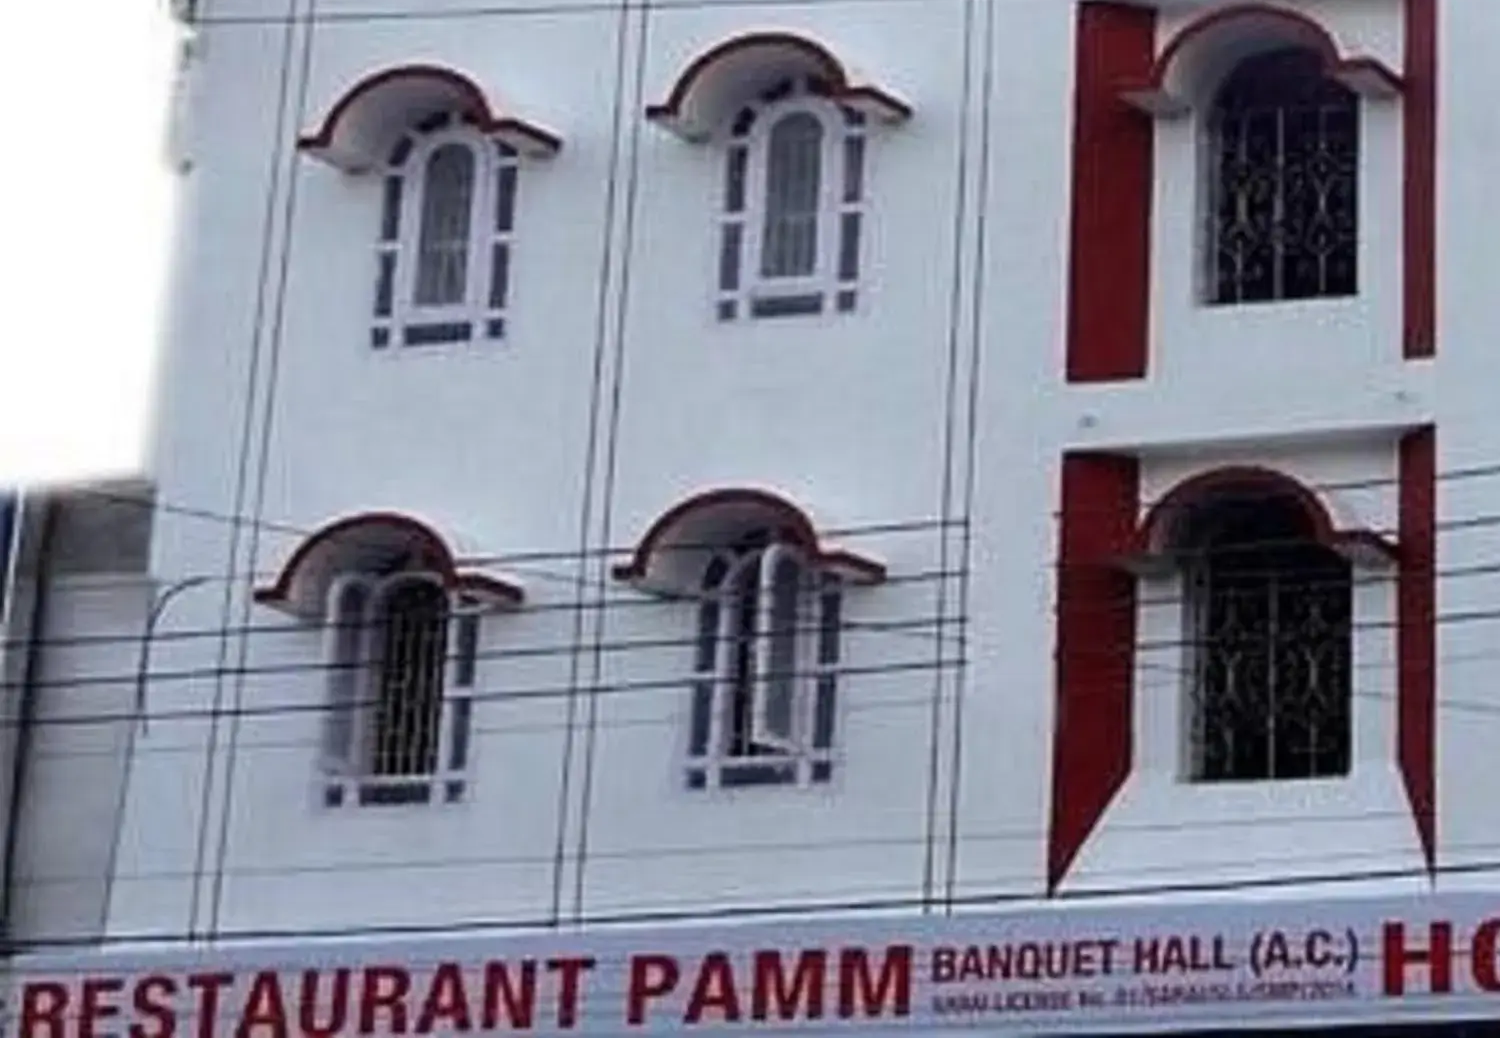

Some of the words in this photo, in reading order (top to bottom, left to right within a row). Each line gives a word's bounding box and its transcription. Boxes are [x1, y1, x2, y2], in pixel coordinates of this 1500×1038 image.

[20, 957, 596, 1038] RESTAURANT
[626, 945, 915, 1025] PAMM
[930, 938, 1120, 984] BANQUET
[1132, 934, 1236, 976] HALL
[1249, 927, 1360, 979] (A.C.)
